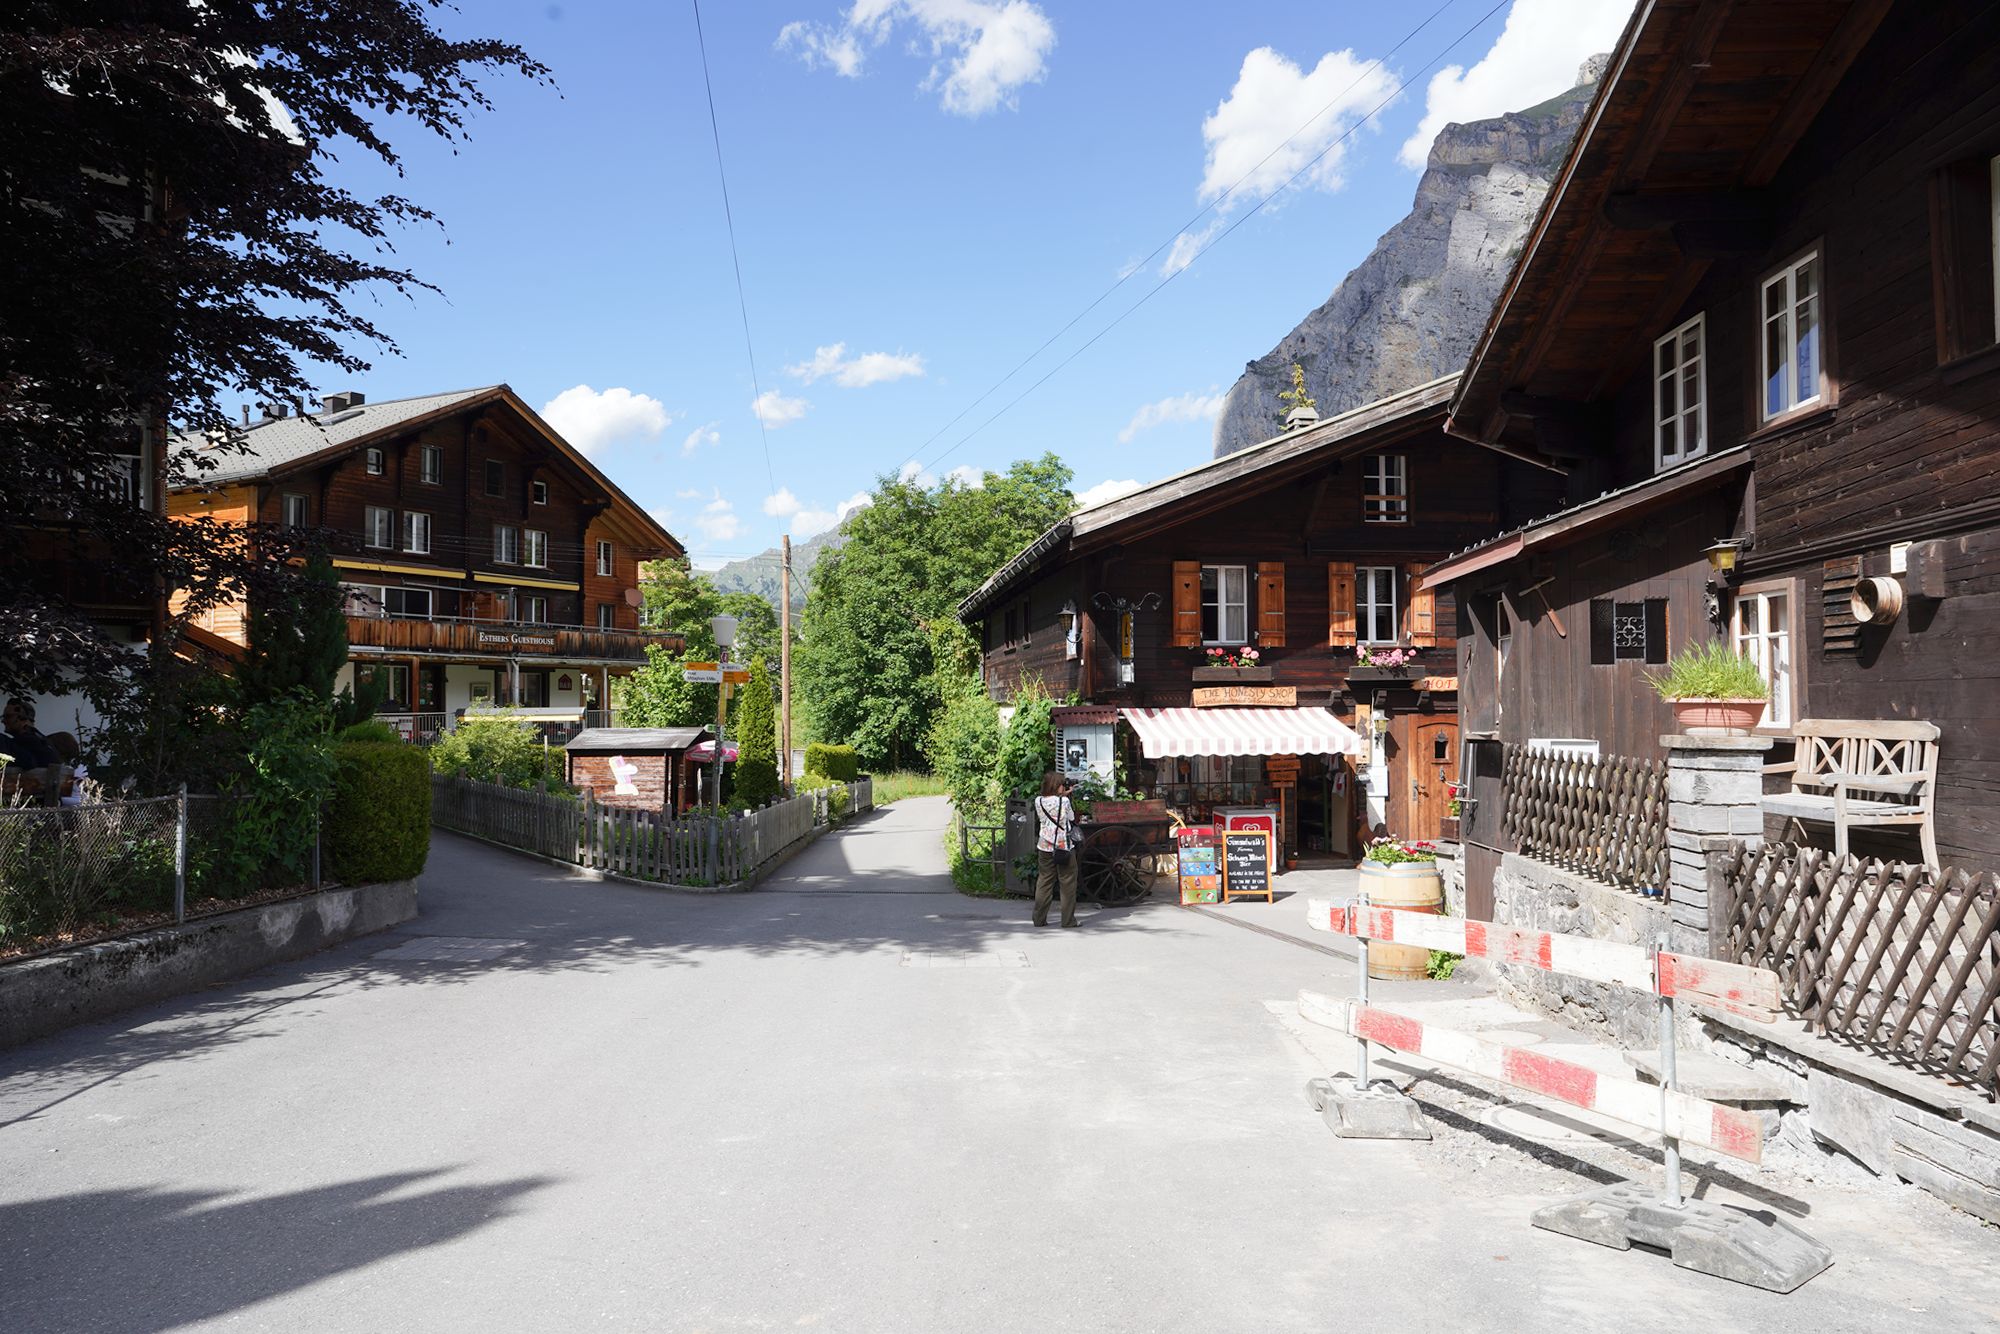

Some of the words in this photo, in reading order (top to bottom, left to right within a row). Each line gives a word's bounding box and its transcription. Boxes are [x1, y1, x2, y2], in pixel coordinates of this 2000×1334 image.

[1424, 679, 1459, 689] HOT
[1201, 689, 1219, 699] THE
[1224, 687, 1266, 699] HONESTY
[1268, 687, 1294, 698] SHOP
